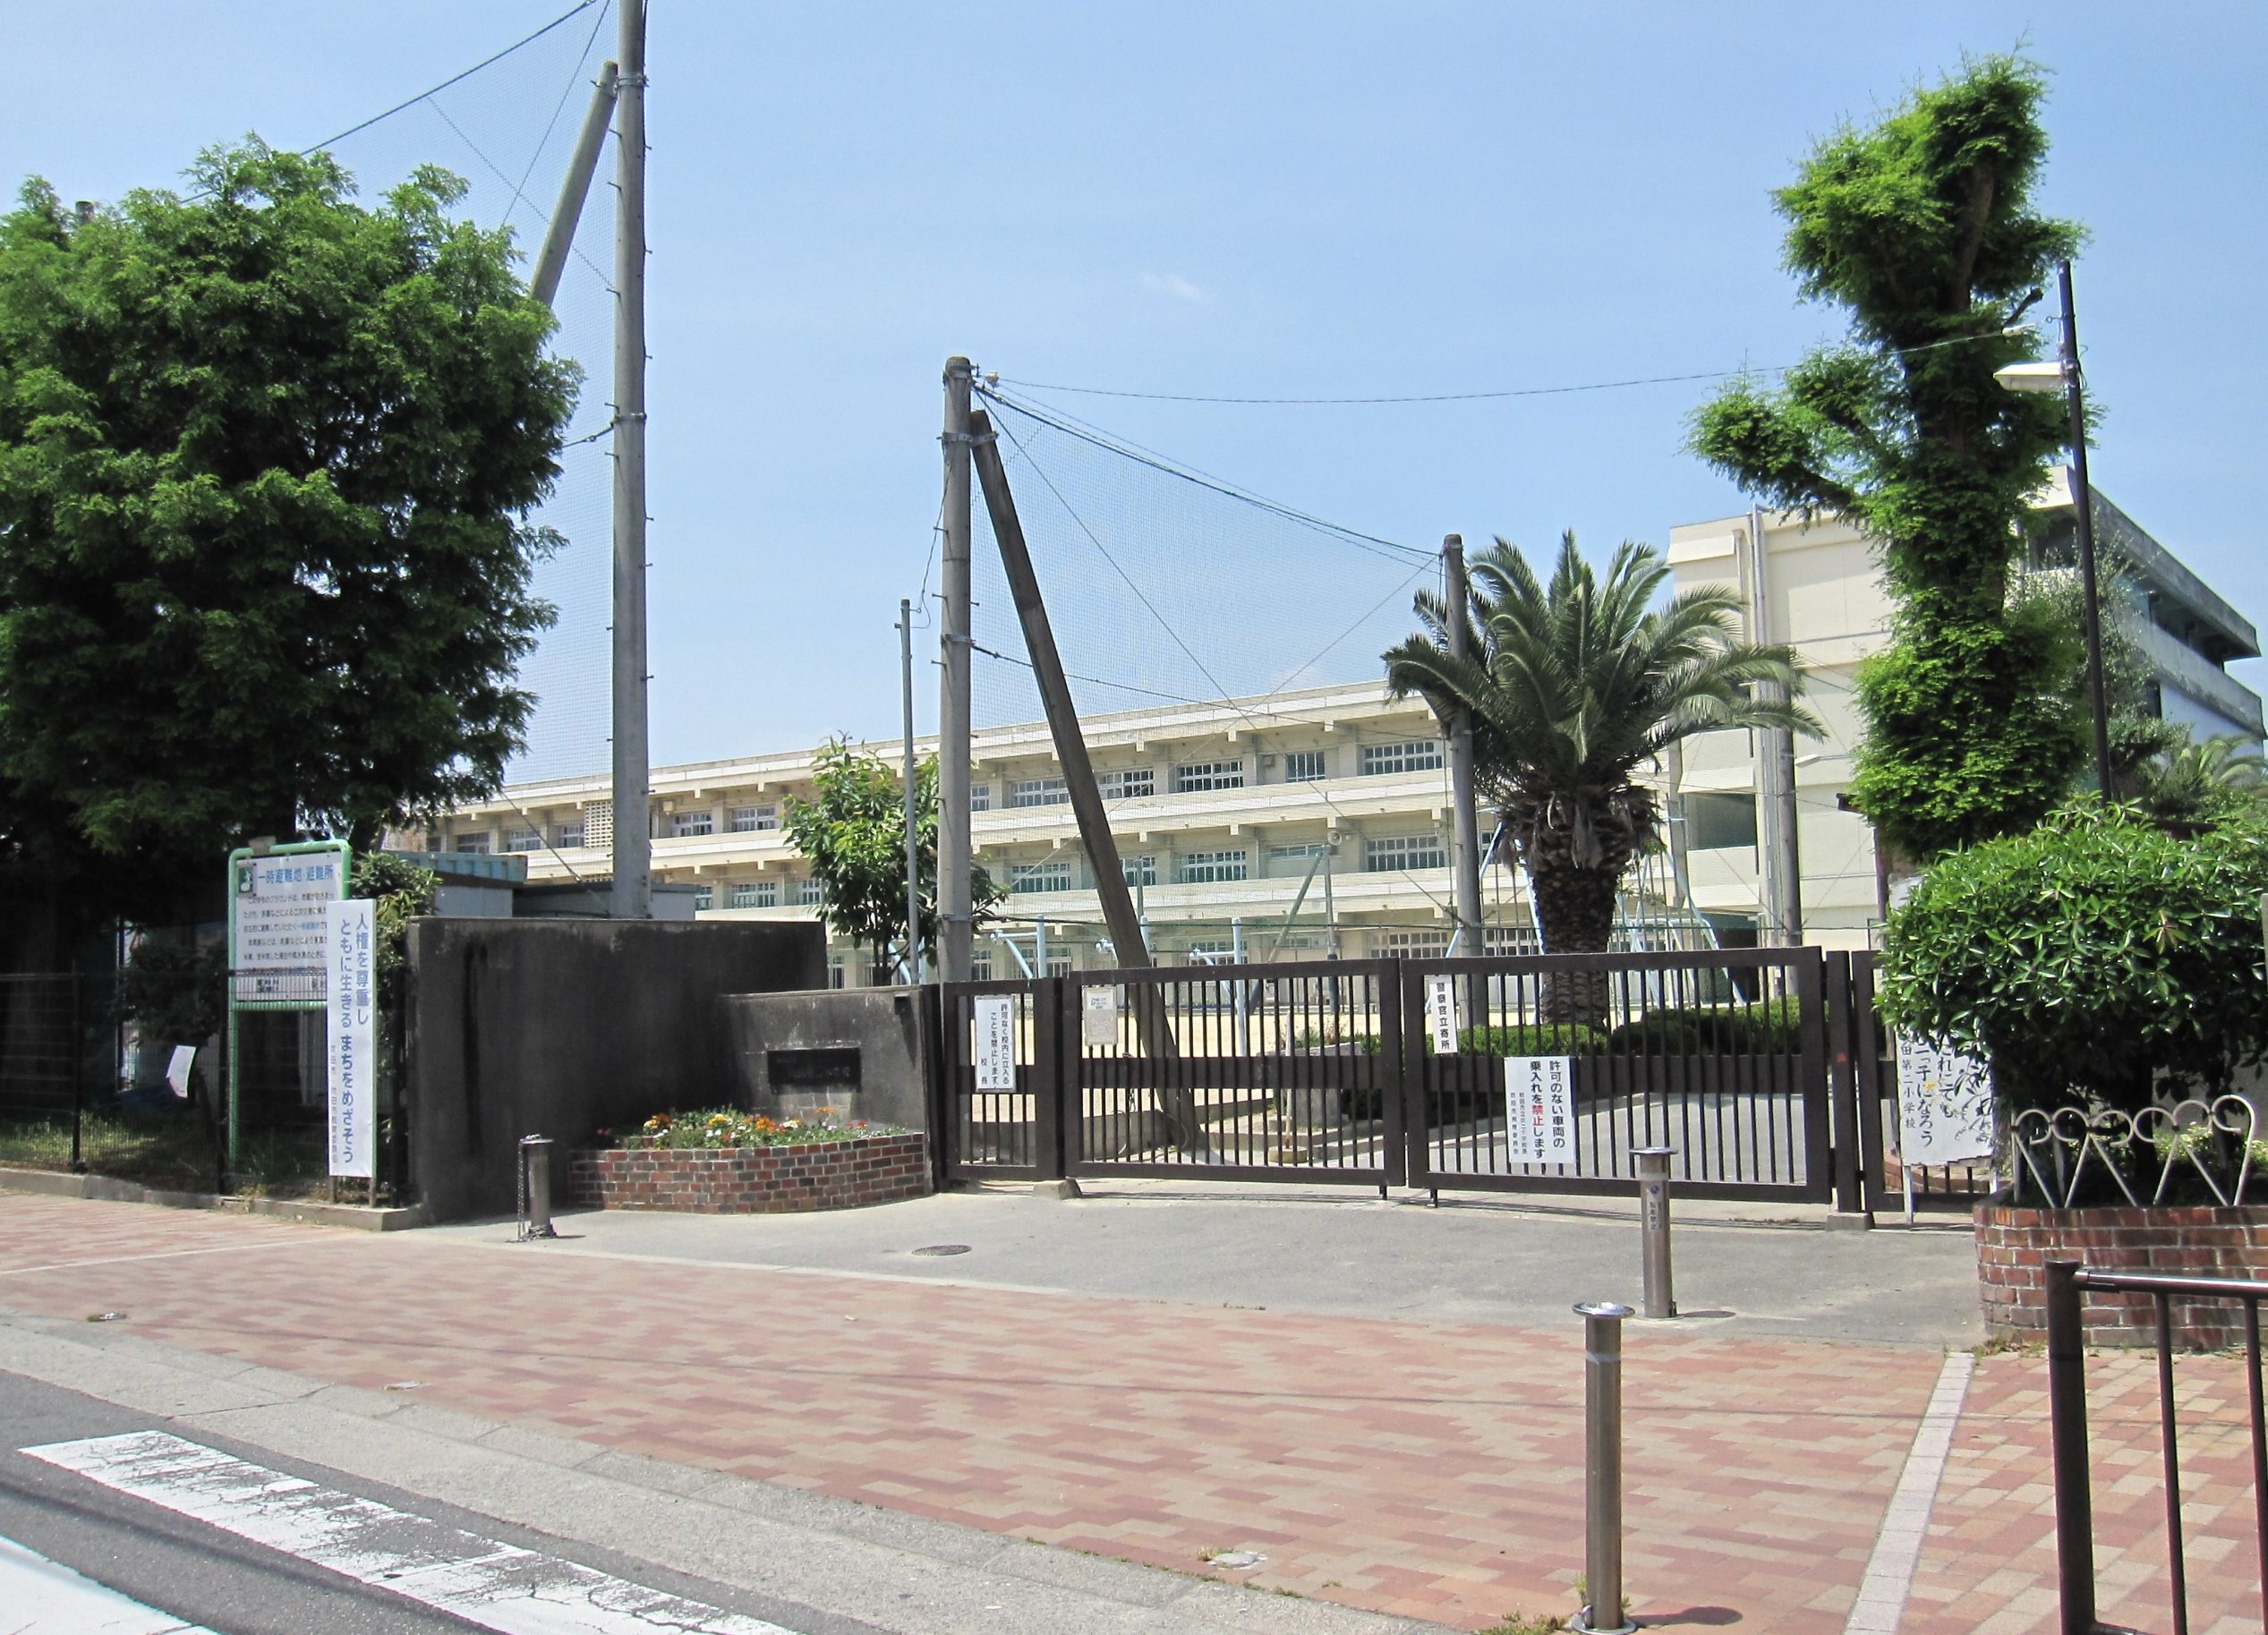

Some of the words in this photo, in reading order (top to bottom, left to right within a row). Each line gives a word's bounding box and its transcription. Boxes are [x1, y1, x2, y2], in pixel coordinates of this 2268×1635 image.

[340, 919, 353, 1029] ともに生きる
[356, 913, 371, 1026] 人権を尊重し
[1437, 982, 1450, 1049] 警察官立寄所
[1001, 1003, 1010, 1085] 許可なく校内に立入る
[1901, 1040, 1916, 1128] 田第二小学校
[340, 1035, 354, 1163] まちをめざそう
[1530, 1060, 1546, 1159] 乗入れを禁止します
[1549, 1060, 1565, 1147] 許可のない車両の
